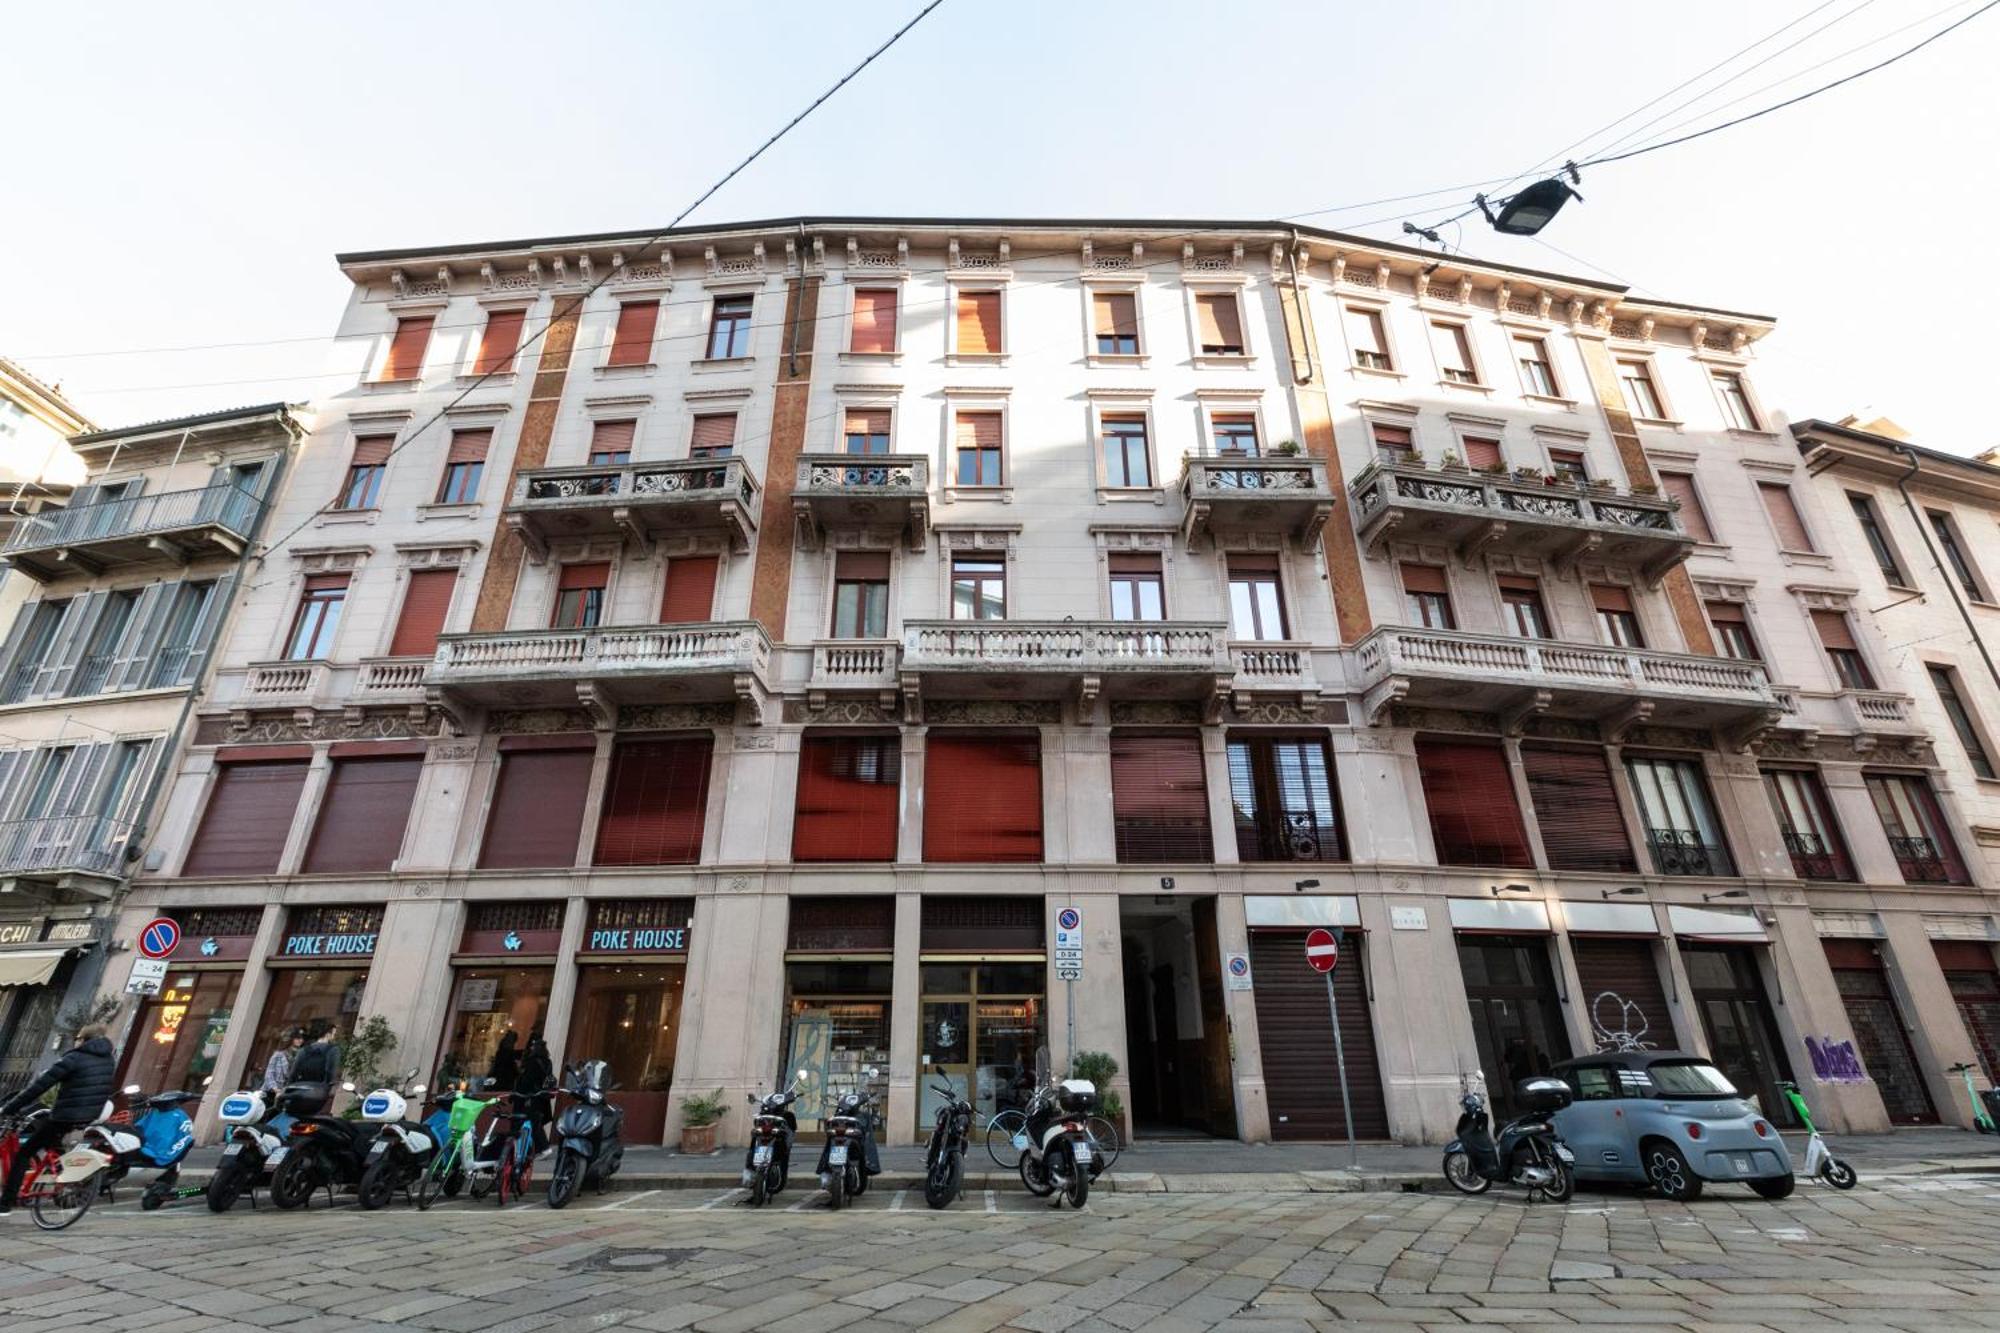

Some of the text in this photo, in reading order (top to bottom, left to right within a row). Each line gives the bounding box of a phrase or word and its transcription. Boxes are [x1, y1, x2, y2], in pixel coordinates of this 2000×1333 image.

[0, 925, 32, 943] CHI
[285, 934, 377, 955] POKE HOUSE
[591, 929, 685, 950] POKE HOUSE
